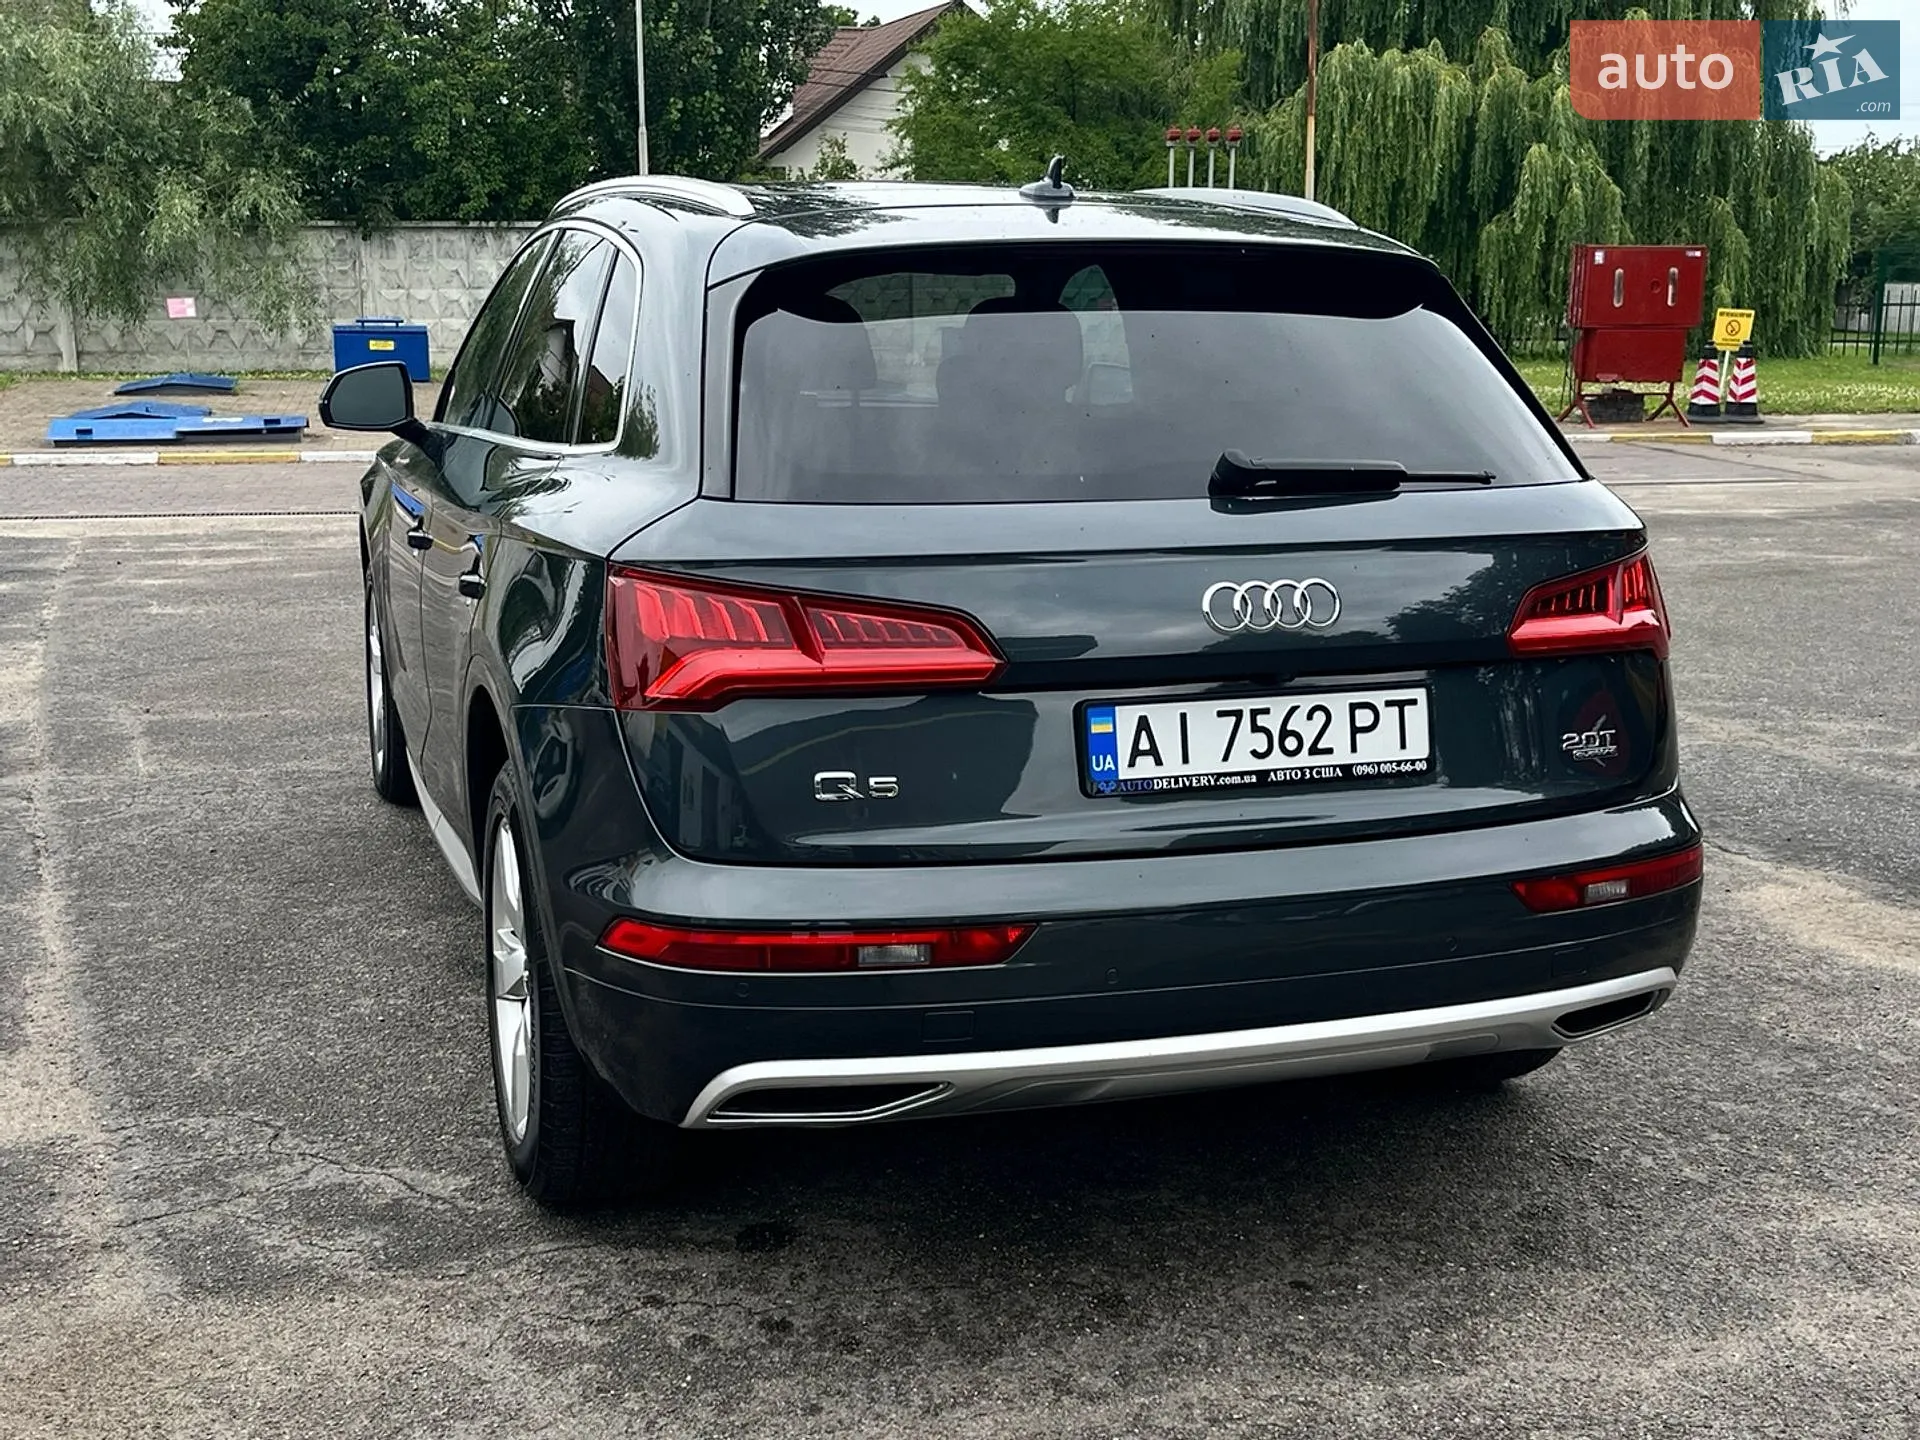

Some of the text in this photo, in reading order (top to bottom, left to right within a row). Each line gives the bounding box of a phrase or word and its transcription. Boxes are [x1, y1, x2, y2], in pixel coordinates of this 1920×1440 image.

[1127, 698, 1418, 768] AI 7562 PT
[1092, 754, 1116, 772] UA
[1352, 760, 1427, 776] (096) 005-66-00
[1117, 774, 1257, 792] AUTODELIVERY.com.ua
[1267, 768, 1301, 782] АВТО
[1312, 766, 1343, 779] США
[814, 771, 899, 800] Q5
